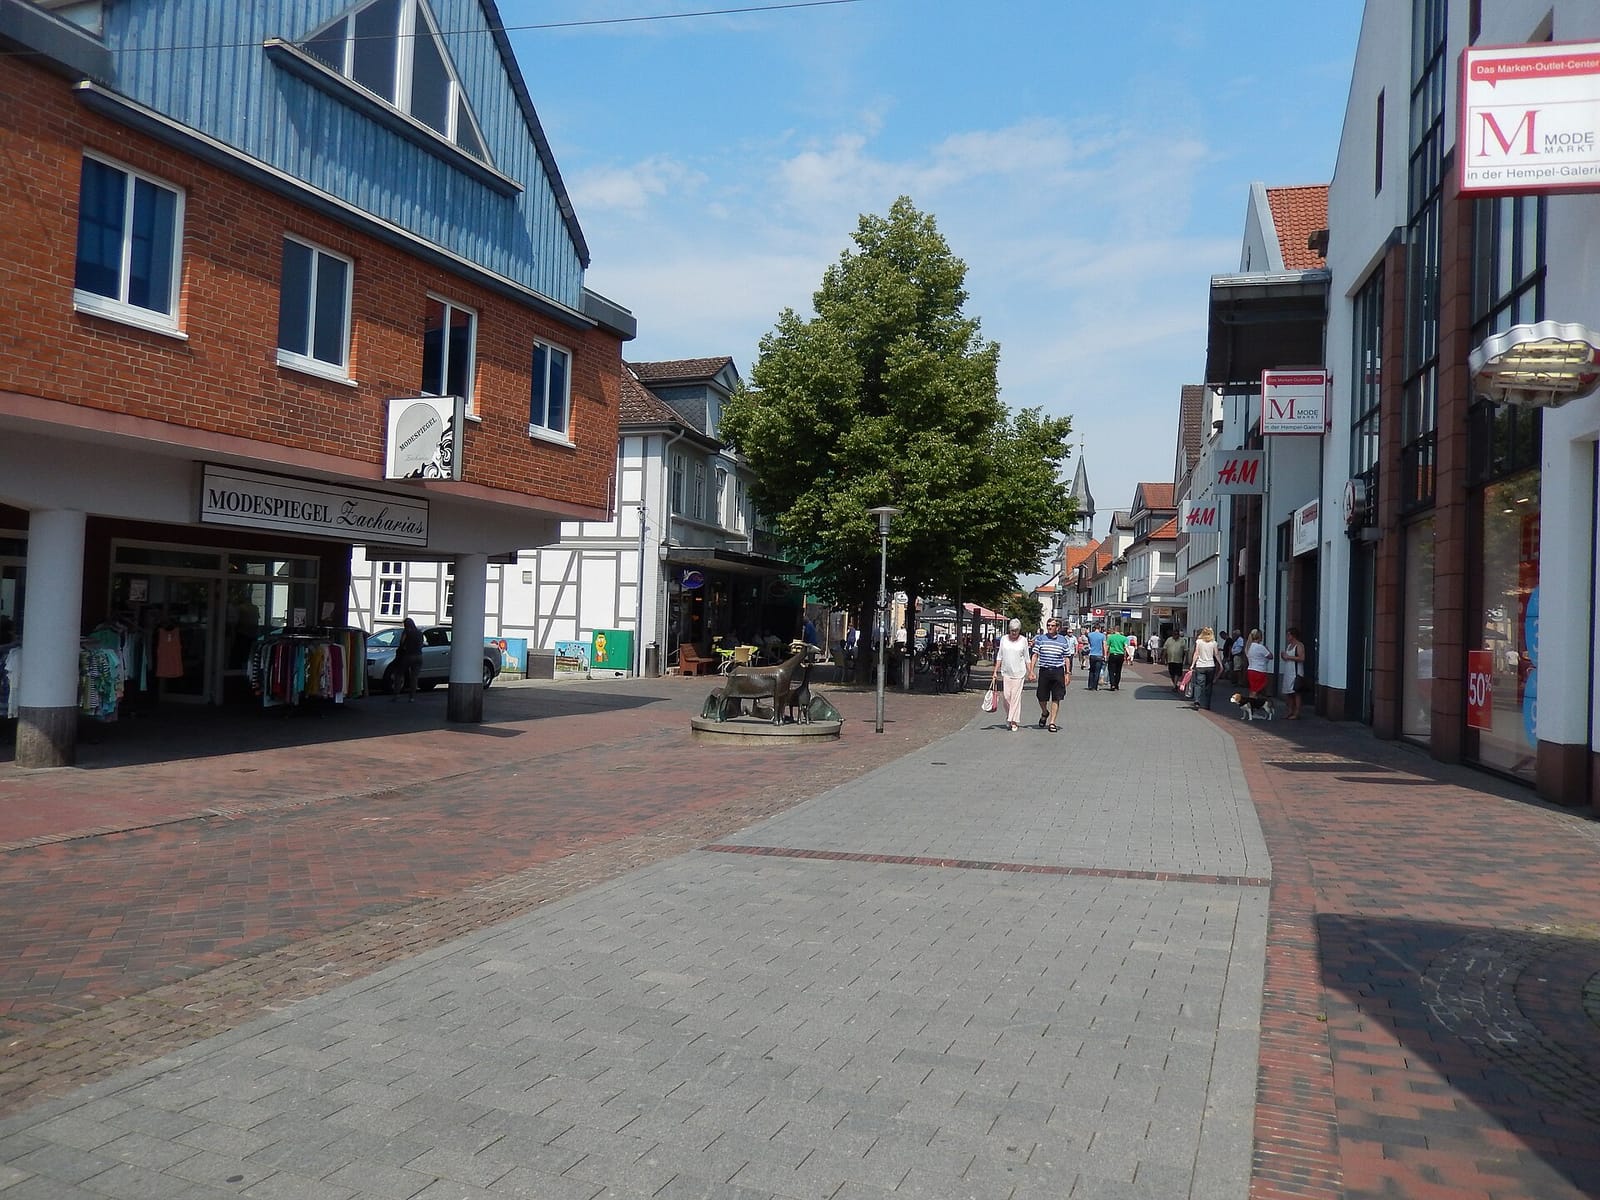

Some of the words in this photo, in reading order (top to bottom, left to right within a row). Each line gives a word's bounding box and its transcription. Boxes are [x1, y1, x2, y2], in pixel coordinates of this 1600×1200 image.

[1477, 66, 1495, 74] Das
[1498, 60, 1600, 73] Marken-Outlet-Center
[1477, 110, 1542, 156] M
[1545, 132, 1594, 145] MODE
[1545, 145, 1593, 154] MARKT
[1468, 171, 1478, 180] in
[1482, 168, 1503, 180] der
[1268, 399, 1296, 419] M
[399, 417, 437, 451] MODESPIEGEL
[1218, 459, 1259, 485] H&M
[208, 489, 332, 523] MODESPIEGEL
[336, 501, 424, 534] Zacharias
[1186, 507, 1216, 526] H&M
[1469, 672, 1492, 707] 50%
